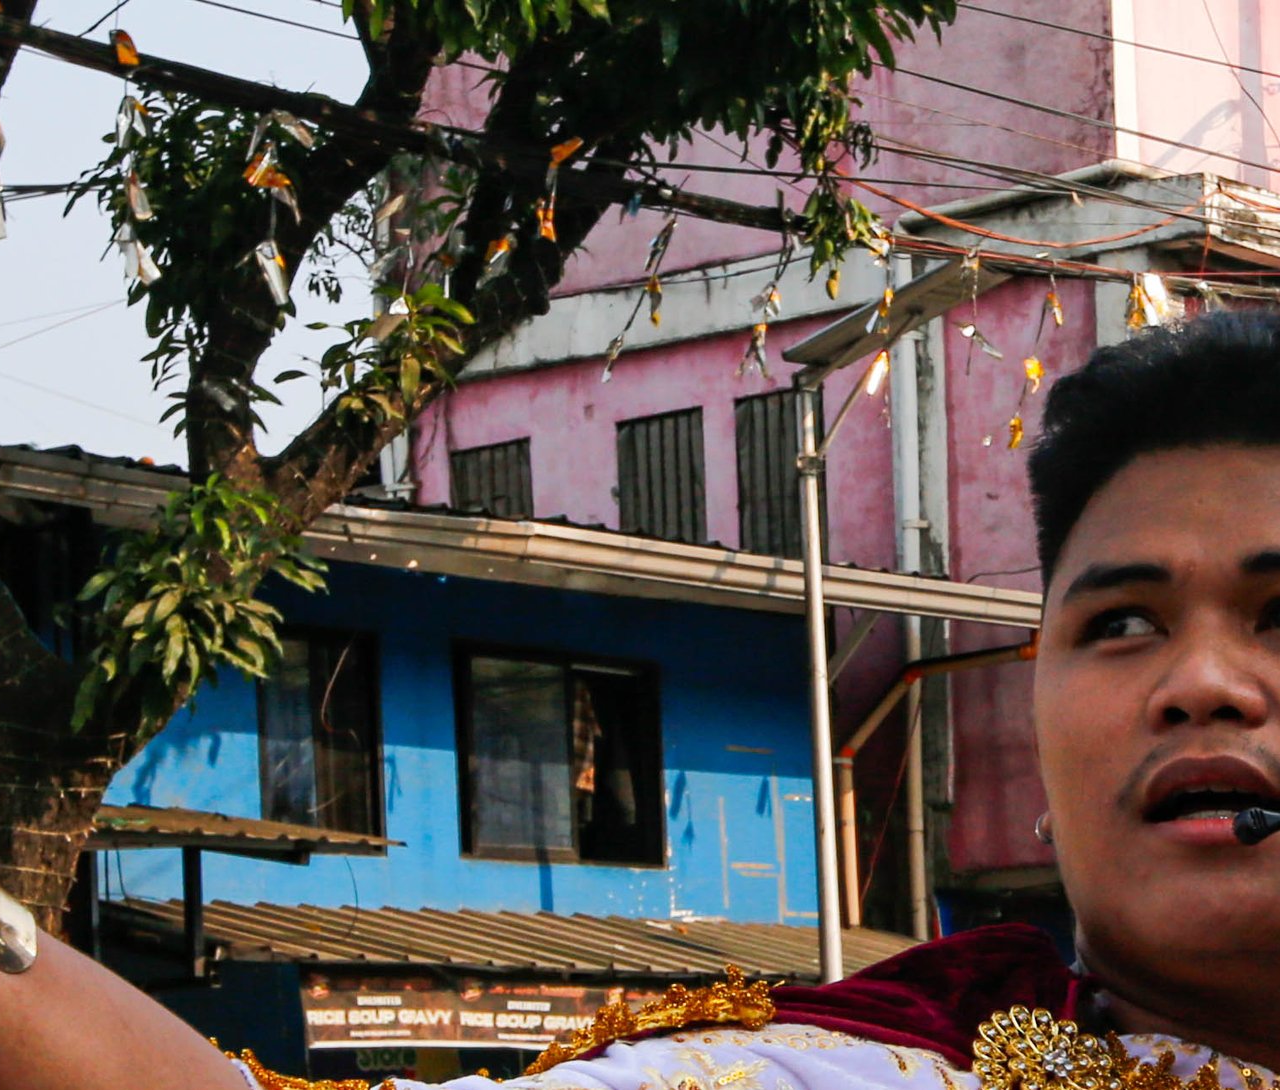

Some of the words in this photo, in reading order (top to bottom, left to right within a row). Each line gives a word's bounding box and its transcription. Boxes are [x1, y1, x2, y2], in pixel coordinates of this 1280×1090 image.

[306, 1009, 346, 1025] RICE
[348, 1009, 395, 1025] SOUP
[495, 1013, 542, 1029] SOUP
